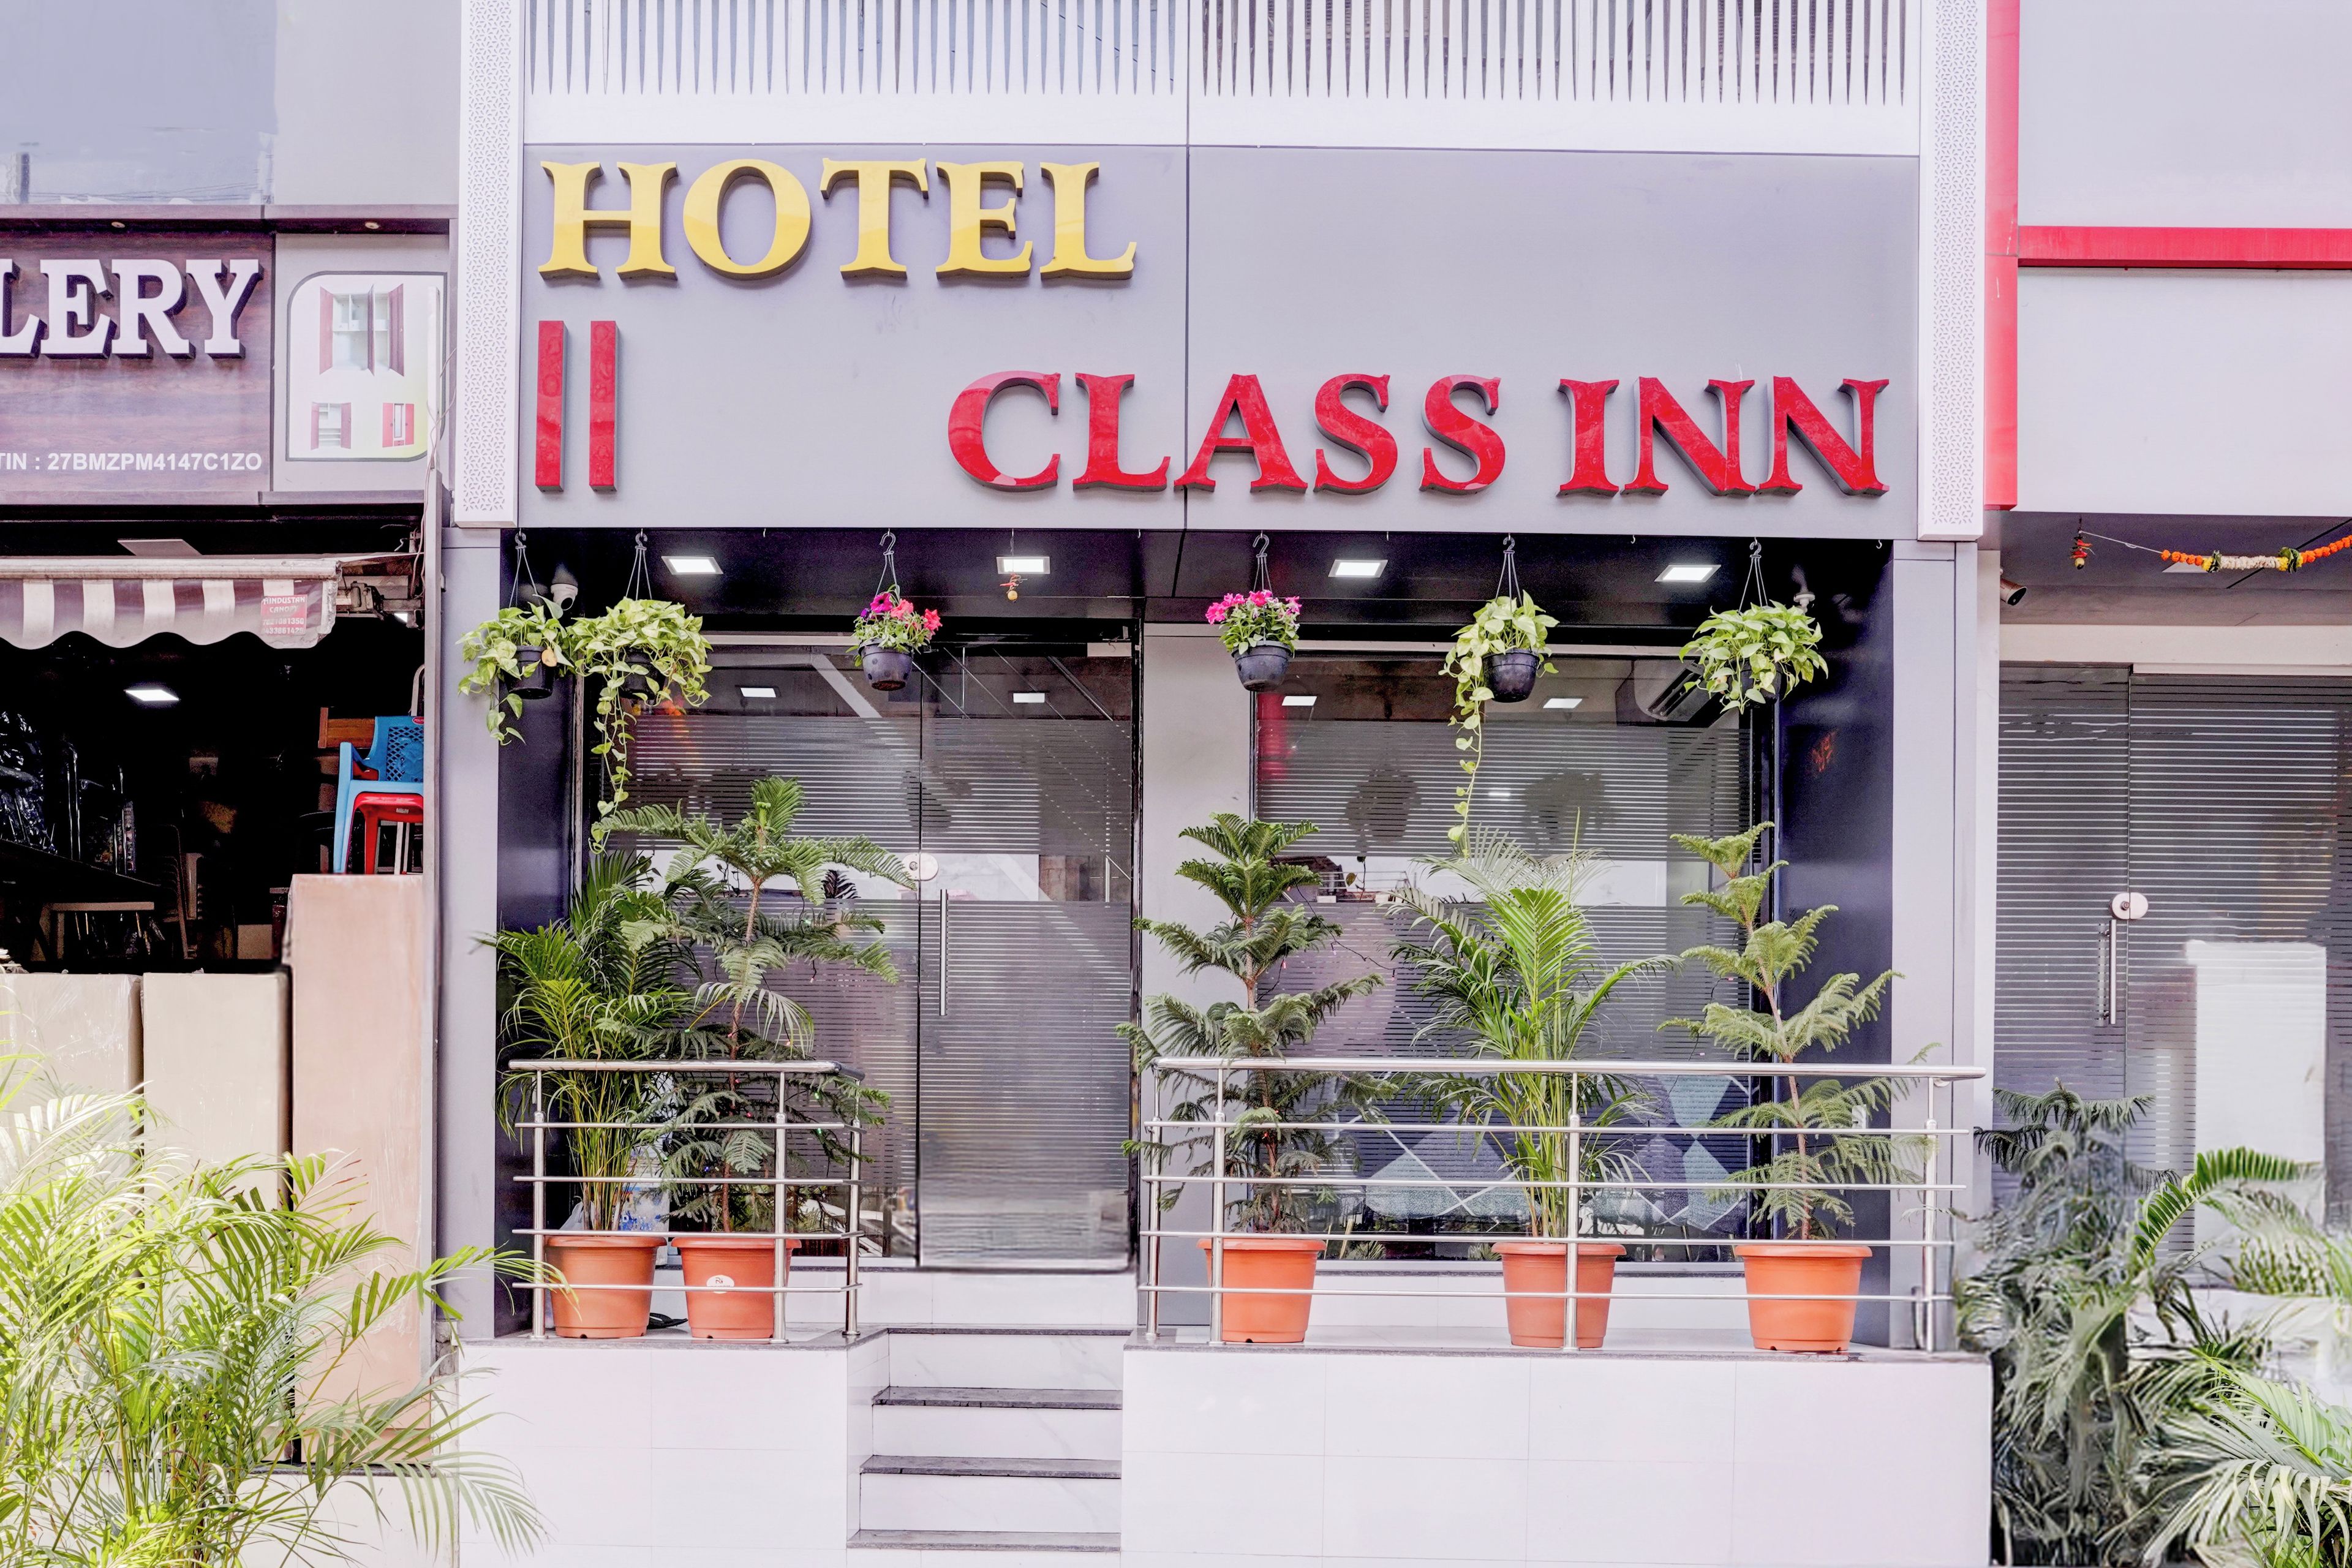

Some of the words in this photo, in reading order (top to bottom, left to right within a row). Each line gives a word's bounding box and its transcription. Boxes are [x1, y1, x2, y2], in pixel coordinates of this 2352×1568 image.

[538, 158, 1137, 281] HOTEL
[947, 370, 1506, 495] CLASS
[1555, 375, 1891, 497] INN
[263, 596, 306, 605] HINDUSTAN
